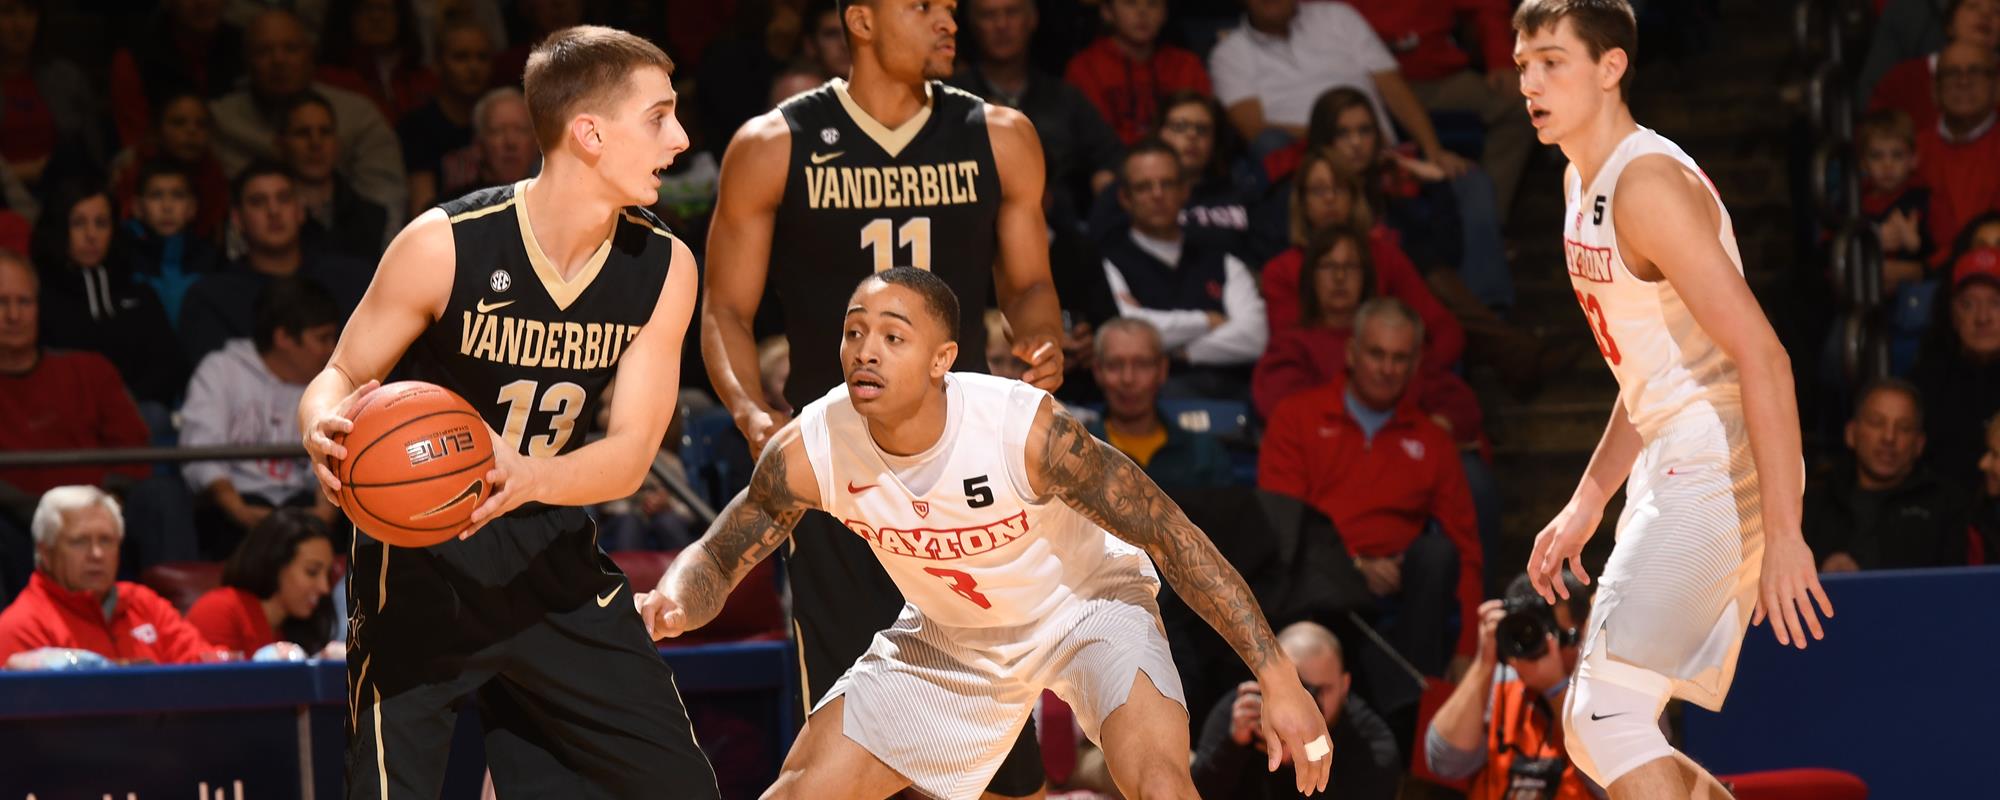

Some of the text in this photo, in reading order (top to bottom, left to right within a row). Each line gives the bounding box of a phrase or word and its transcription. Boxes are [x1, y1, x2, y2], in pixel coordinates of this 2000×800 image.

[805, 160, 979, 209] VANDERBILT
[1593, 195, 1606, 226] 5
[860, 216, 931, 274] 11
[496, 379, 587, 457] 13
[407, 432, 475, 466] ELITE
[963, 475, 994, 509] 5
